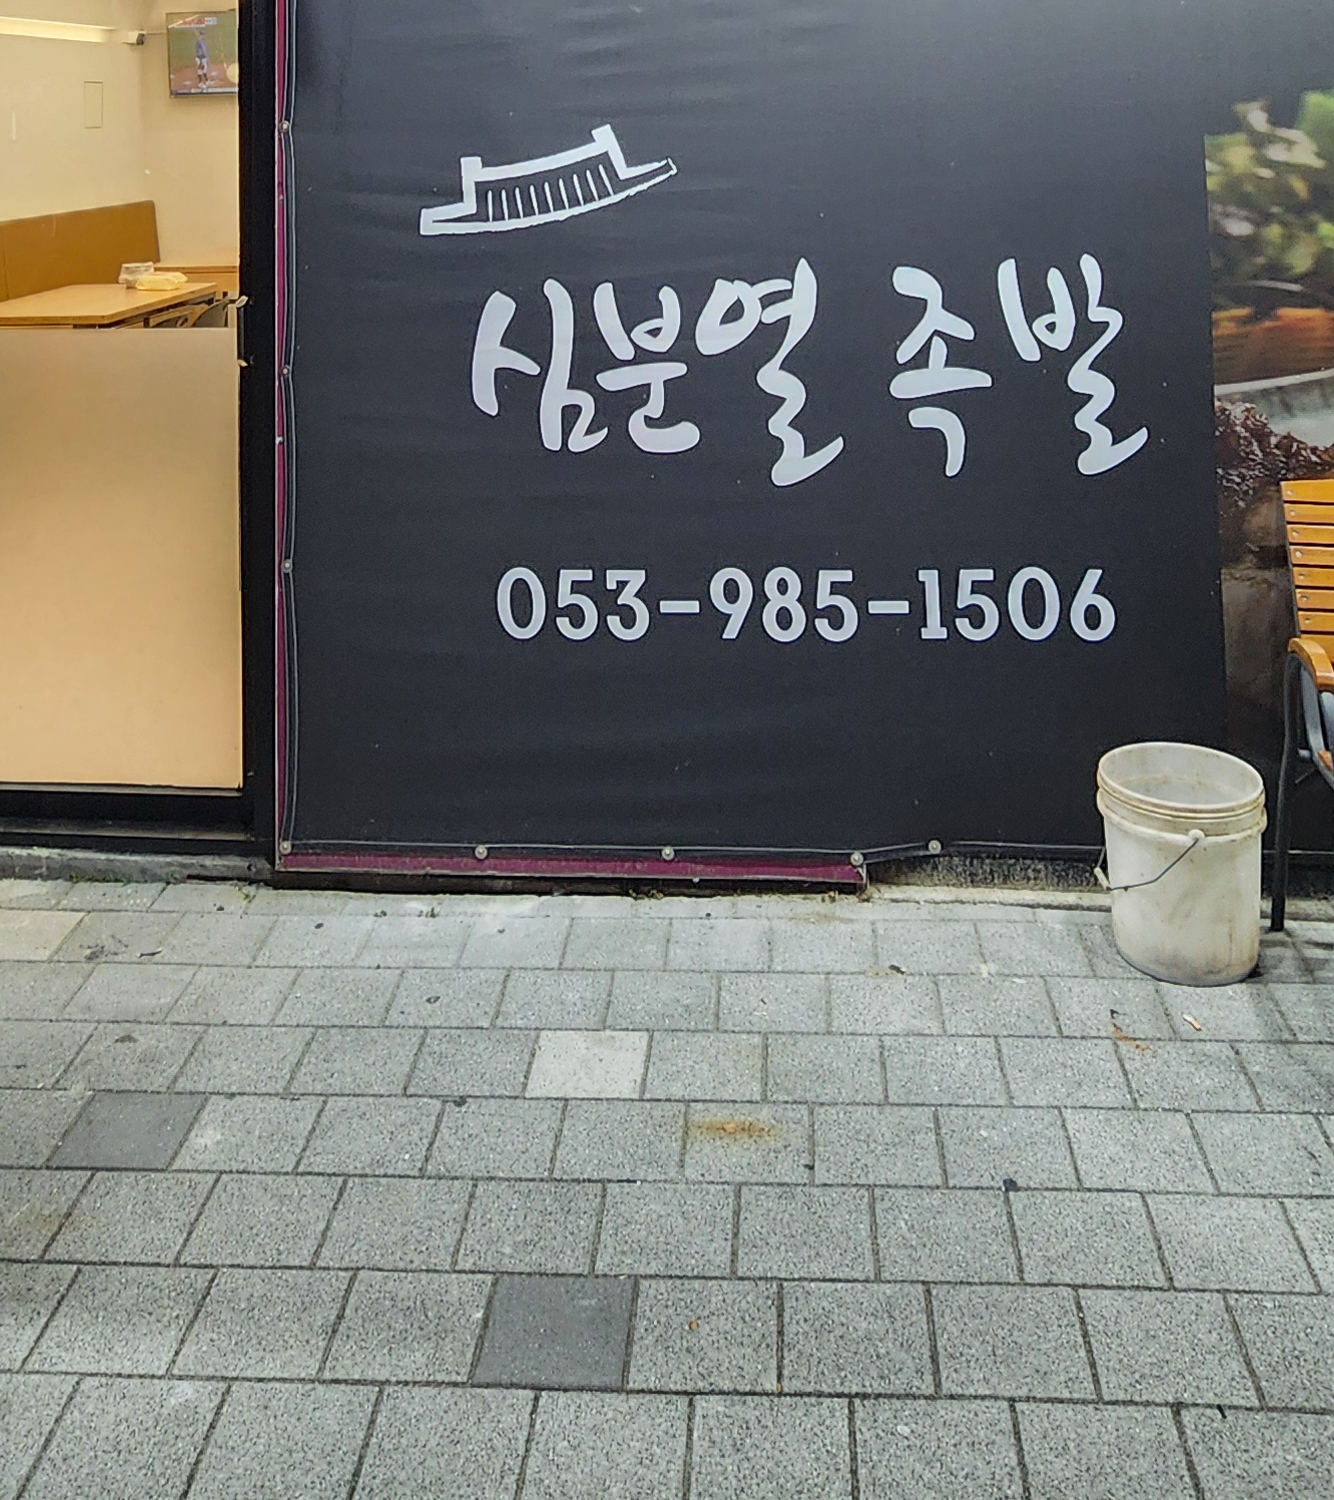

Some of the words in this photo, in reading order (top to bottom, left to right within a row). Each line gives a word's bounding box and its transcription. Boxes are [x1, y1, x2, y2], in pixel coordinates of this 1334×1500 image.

[471, 256, 845, 487] 심분열
[888, 253, 1148, 478] 족발
[496, 566, 1117, 643] 053-985-1506
